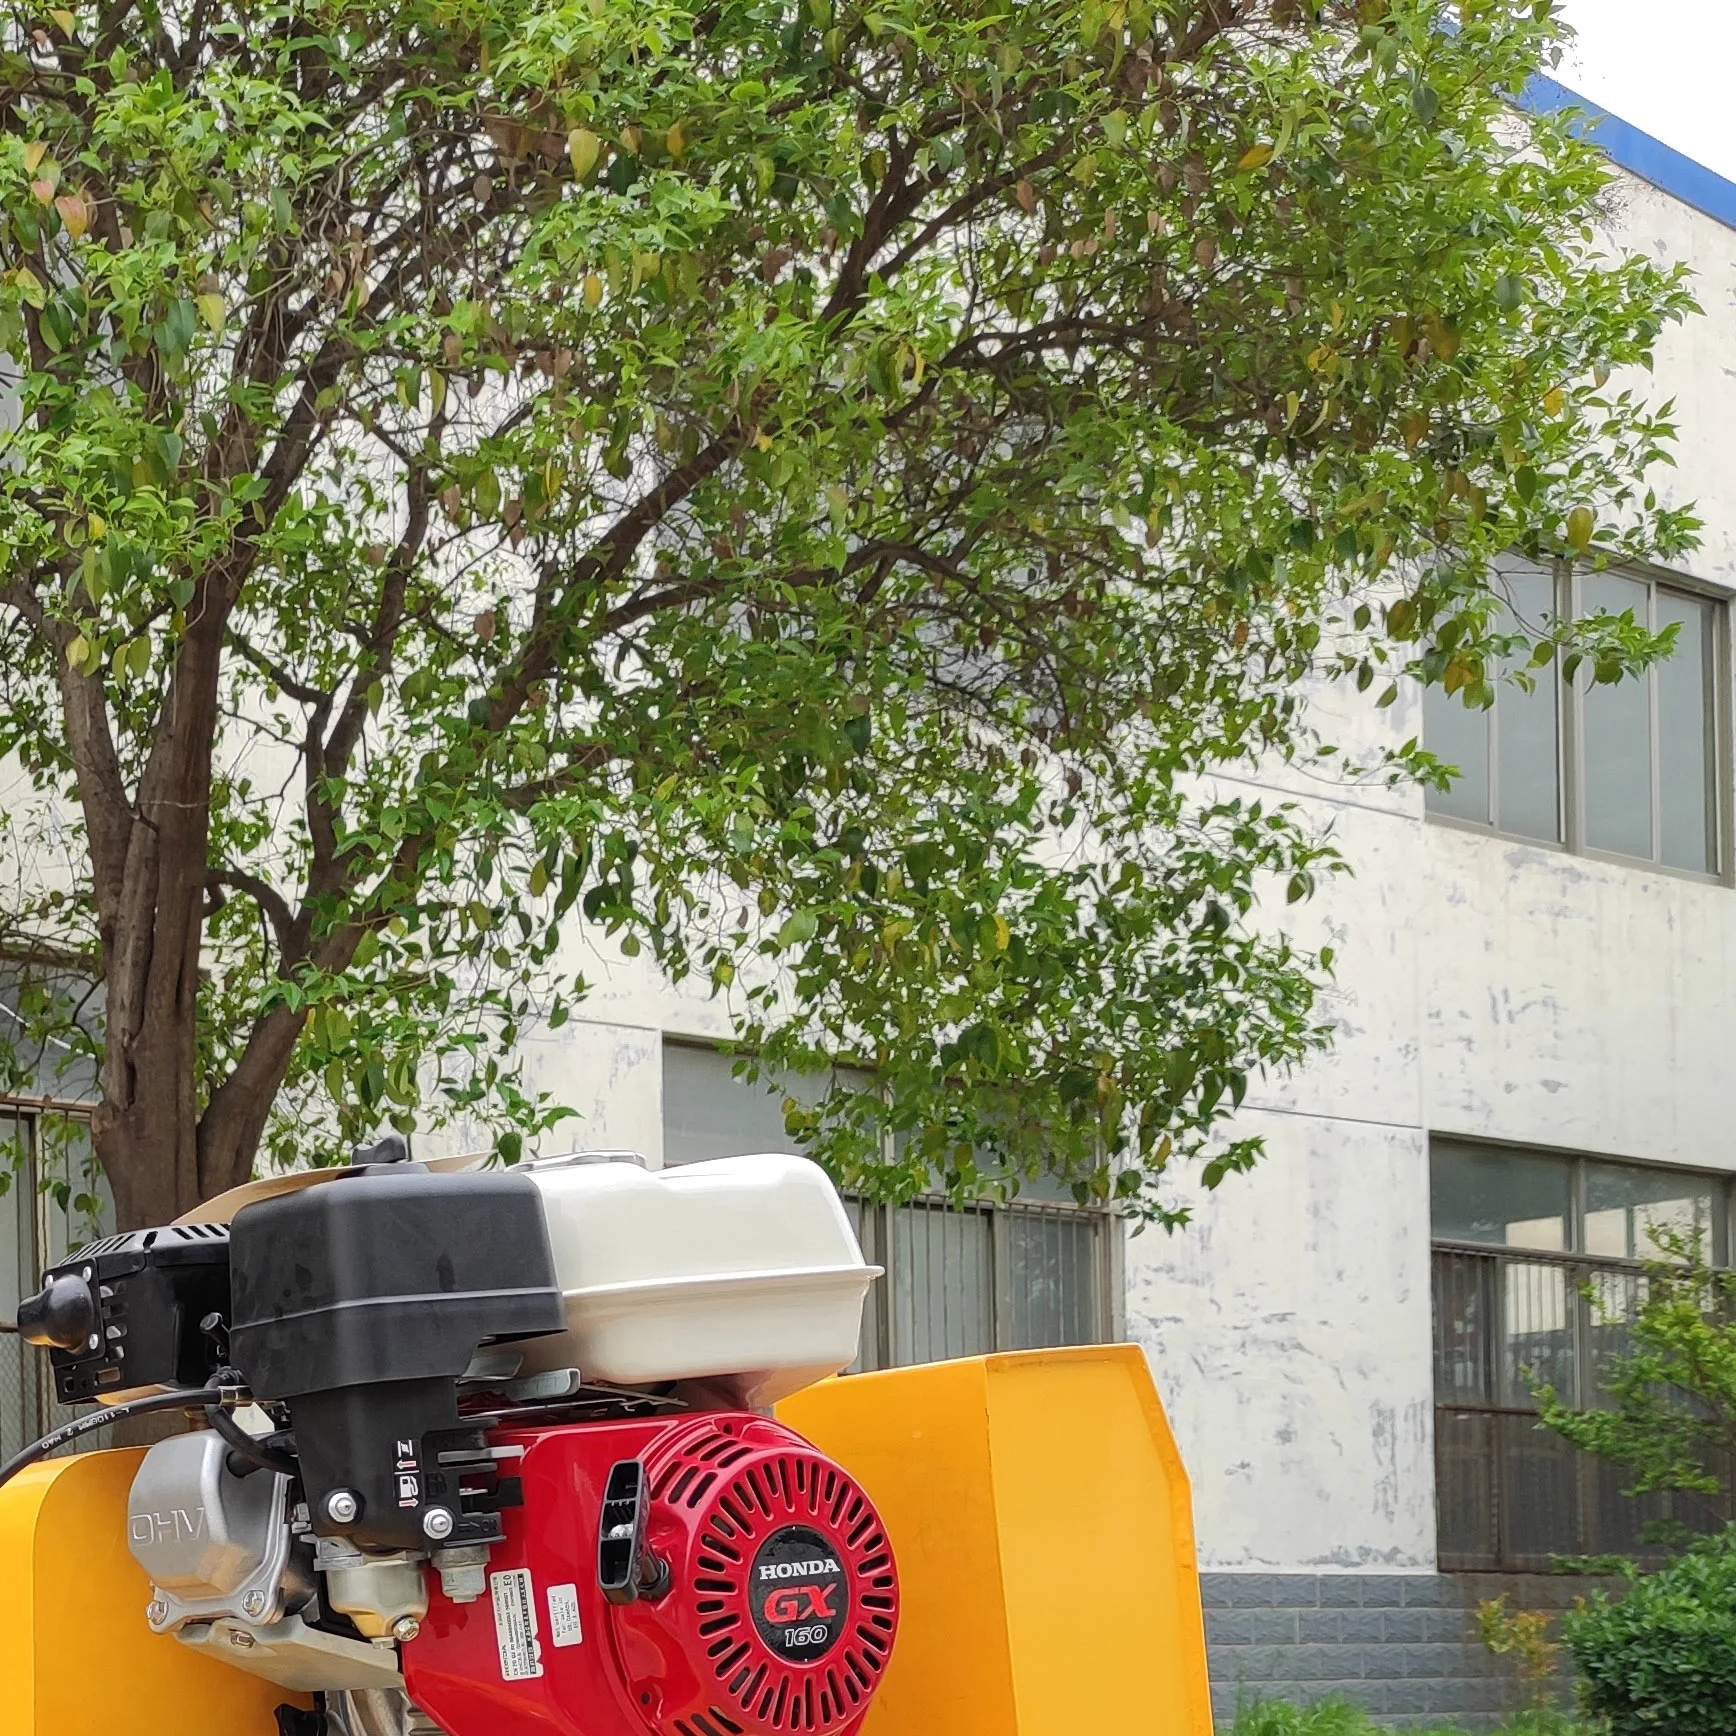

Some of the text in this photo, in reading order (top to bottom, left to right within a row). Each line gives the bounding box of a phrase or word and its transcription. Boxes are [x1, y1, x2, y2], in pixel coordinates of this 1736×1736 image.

[130, 1507, 205, 1546] OHV
[758, 1558, 841, 1580] HONDA
[764, 1582, 838, 1625] GX
[785, 1624, 828, 1648] 160
